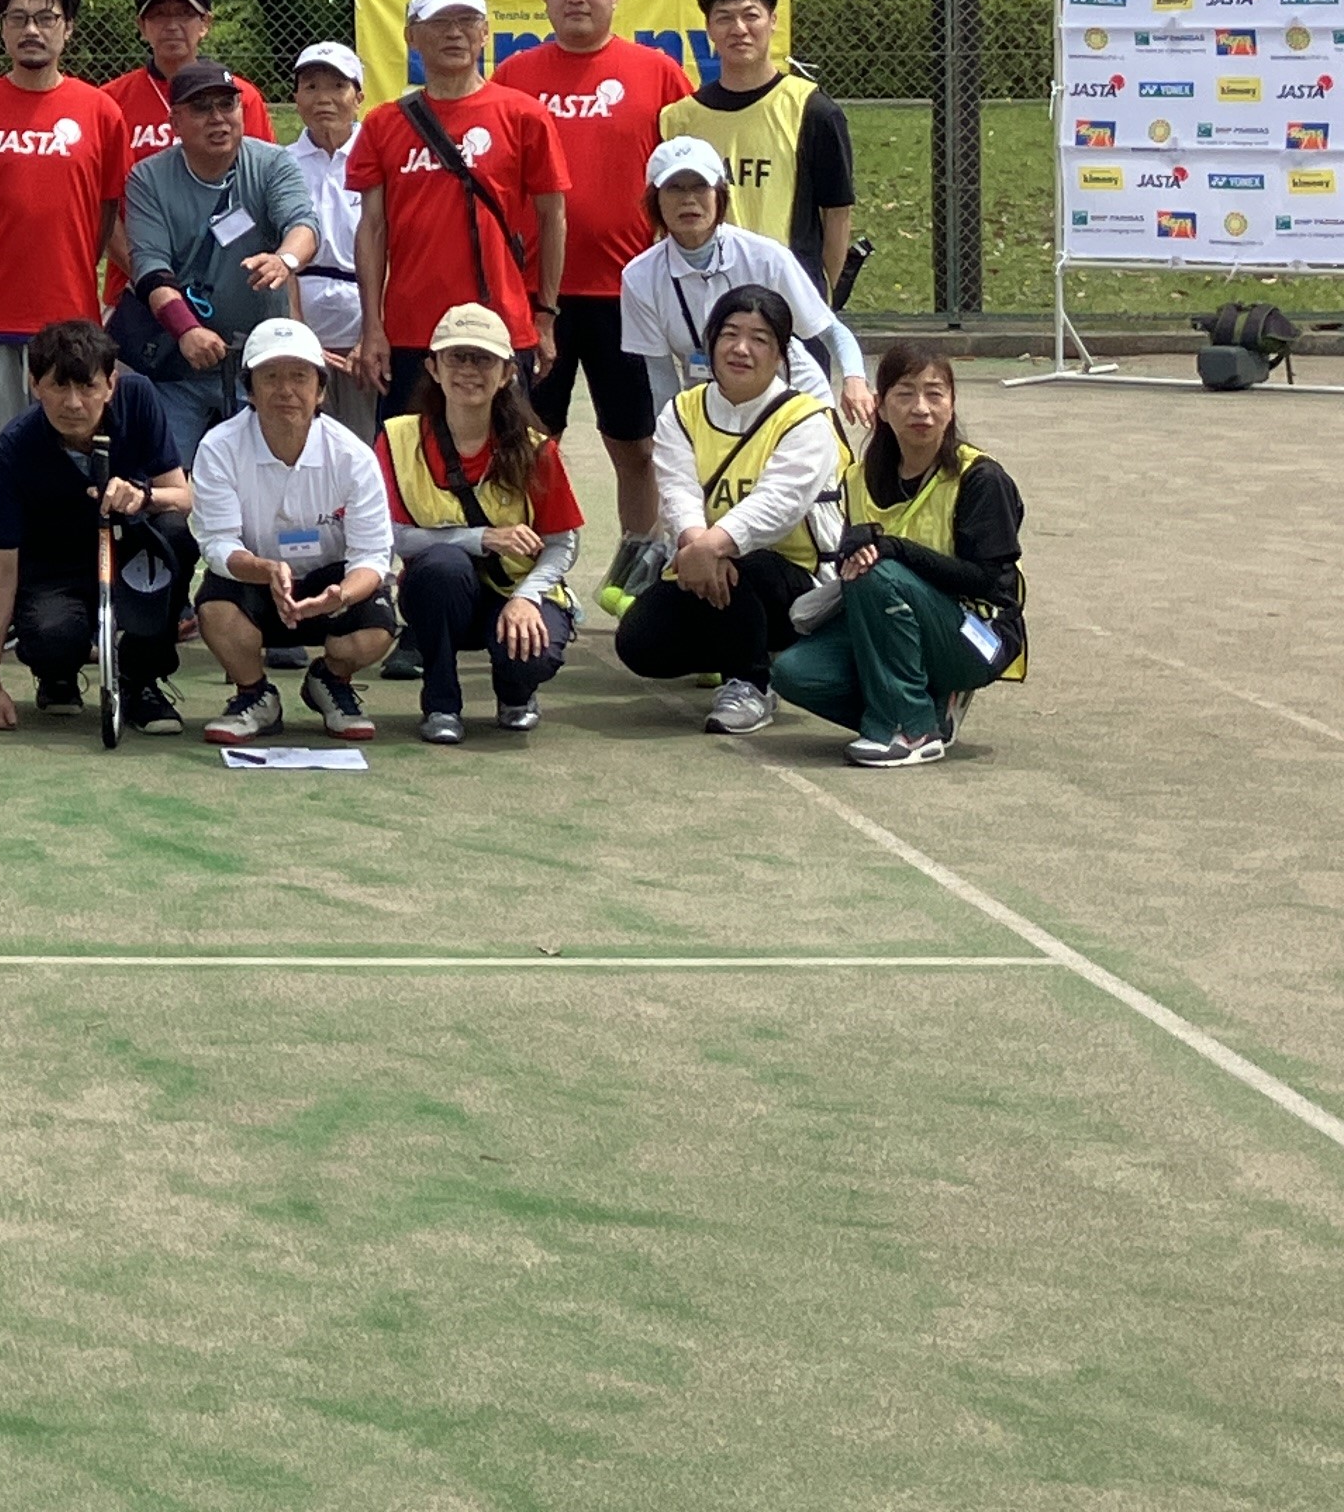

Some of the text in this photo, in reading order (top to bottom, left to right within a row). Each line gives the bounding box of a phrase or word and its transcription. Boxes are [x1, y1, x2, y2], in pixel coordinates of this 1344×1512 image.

[1069, 83, 1117, 98] JASTA
[1277, 84, 1325, 99] JASTA
[131, 124, 182, 148] JAS
[401, 145, 476, 174] JAA
[724, 157, 771, 187] AFF
[1137, 174, 1181, 188] JASTA
